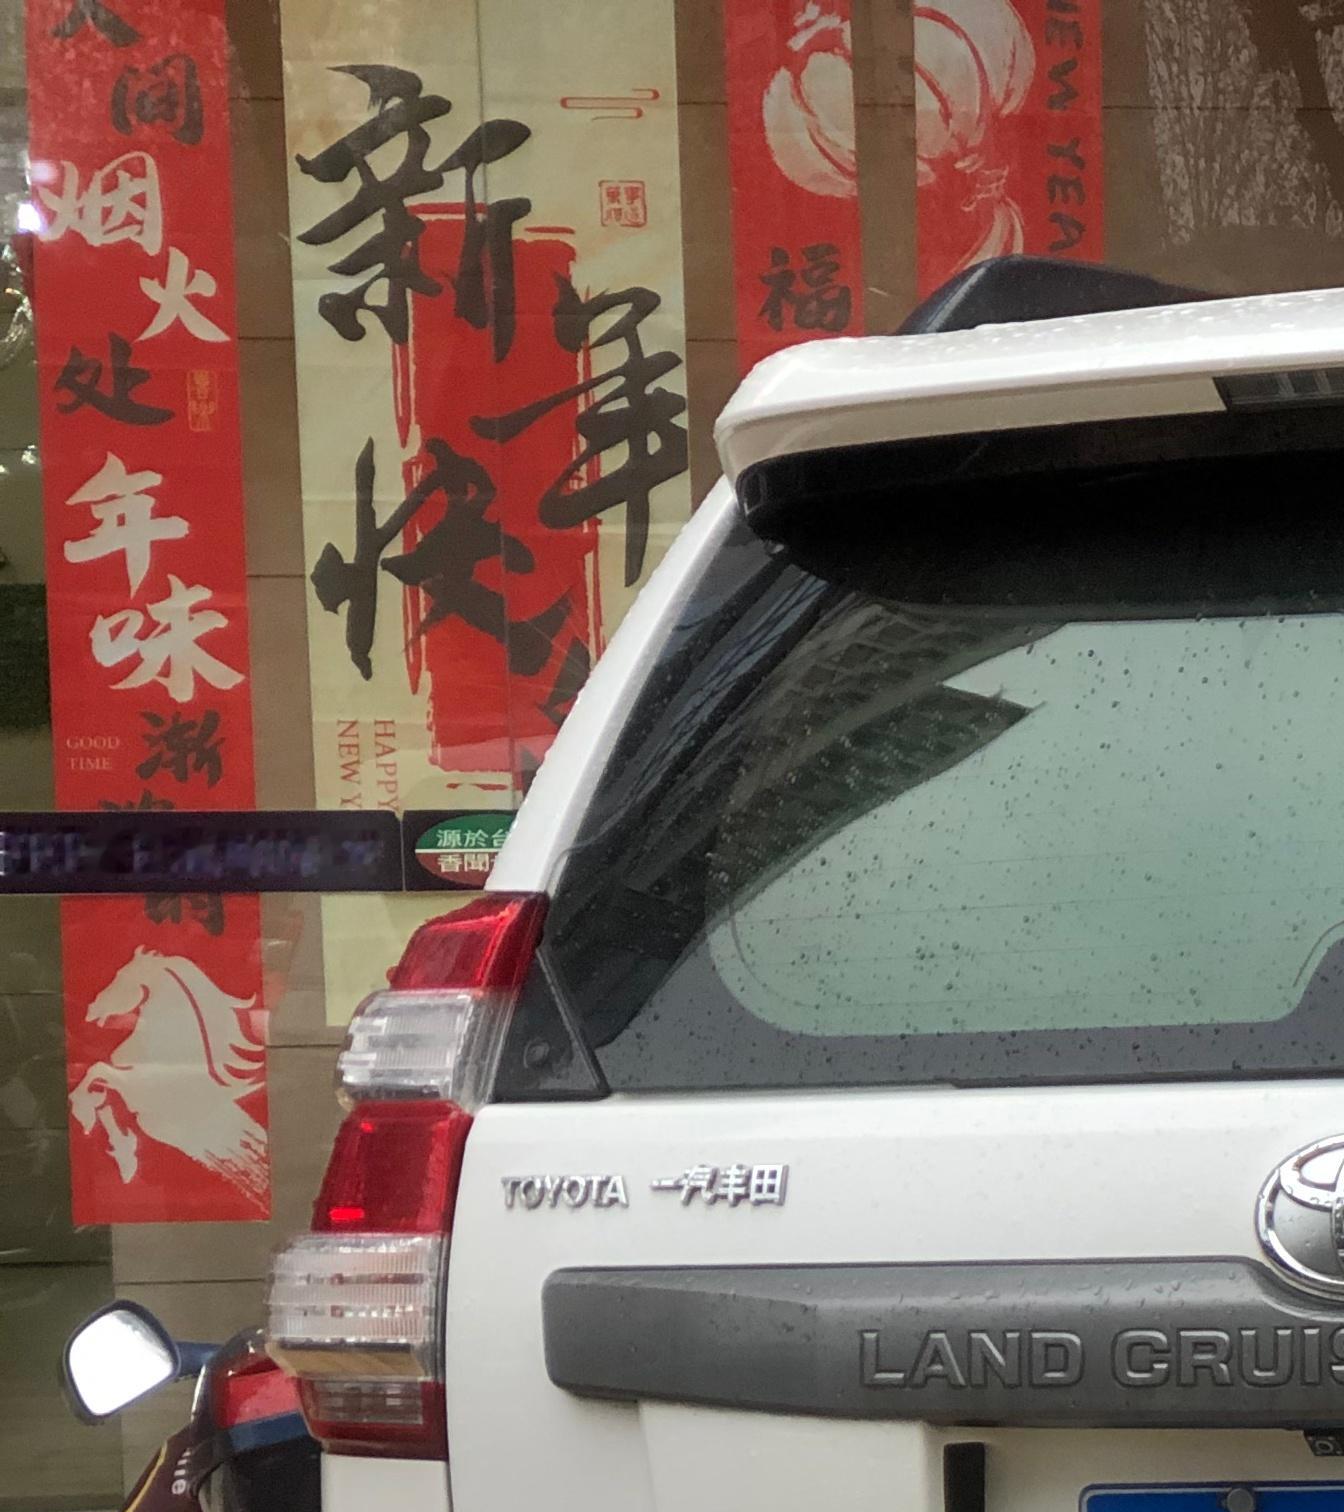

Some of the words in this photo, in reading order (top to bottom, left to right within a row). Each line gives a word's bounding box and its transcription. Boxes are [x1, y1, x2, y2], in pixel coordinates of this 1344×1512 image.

[1046, 137, 1086, 252] YEA
[757, 243, 853, 334] 福
[66, 735, 121, 750] GOOD
[66, 757, 113, 771] TIME
[337, 719, 361, 785] NEW
[374, 719, 400, 812] HAPPY
[436, 829, 507, 848] 源於台
[437, 853, 494, 873] 香聞
[501, 1176, 630, 1208] TOYOTA
[650, 1164, 790, 1207] 一汽丰田
[858, 1328, 1087, 1389] LAND
